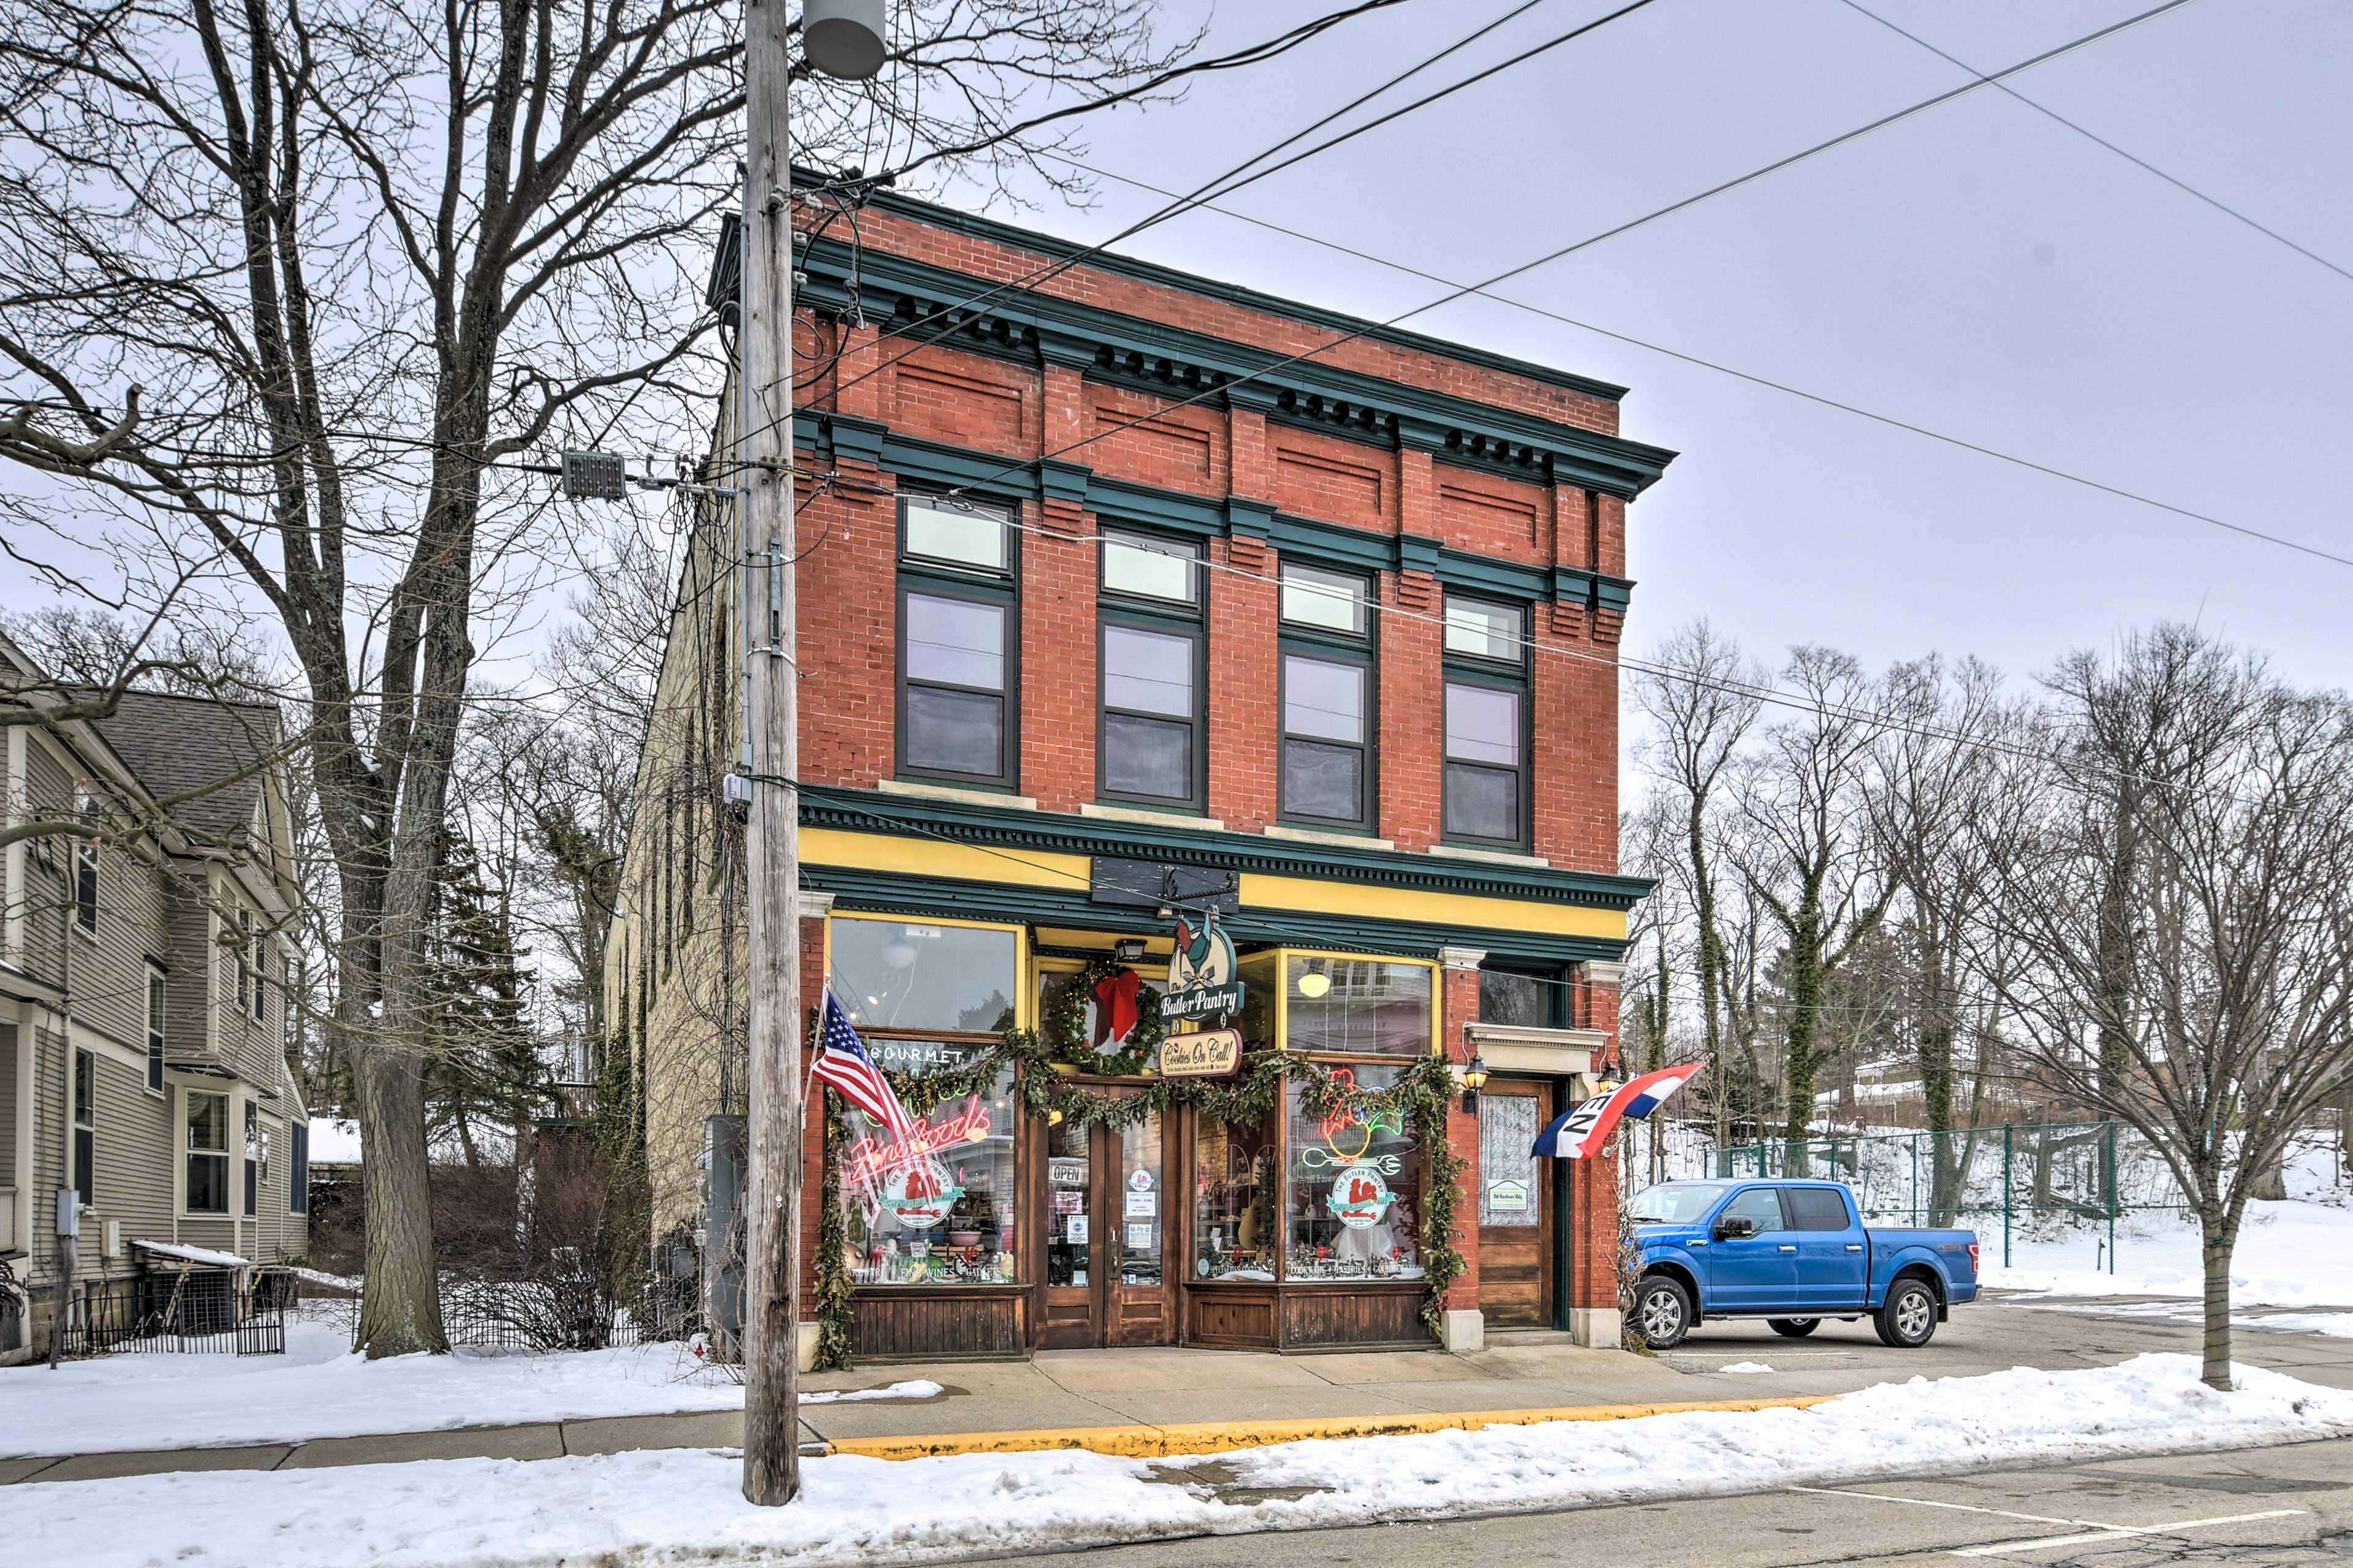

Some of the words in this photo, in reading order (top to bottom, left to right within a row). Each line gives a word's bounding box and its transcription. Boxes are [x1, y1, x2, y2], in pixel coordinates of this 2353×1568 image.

[1170, 982, 1181, 992] The
[1161, 995, 1195, 1016] Butler
[1195, 990, 1237, 1014] Pantry
[870, 1047, 963, 1064] GOURMET
[1164, 1042, 1191, 1066] Cookies
[1192, 1042, 1206, 1064] On
[1207, 1037, 1233, 1063] Call!
[850, 1136, 908, 1179] Fine
[904, 1094, 991, 1157] Foods
[889, 1174, 900, 1187] THE
[930, 1164, 950, 1187] PANTRY
[1054, 1166, 1079, 1181] OPEN
[1336, 1181, 1345, 1192] THE
[1344, 1170, 1365, 1181] BUTLER
[1367, 1170, 1384, 1192] PANTRY
[925, 1268, 955, 1277] WINES
[965, 1267, 1001, 1277] GADETS
